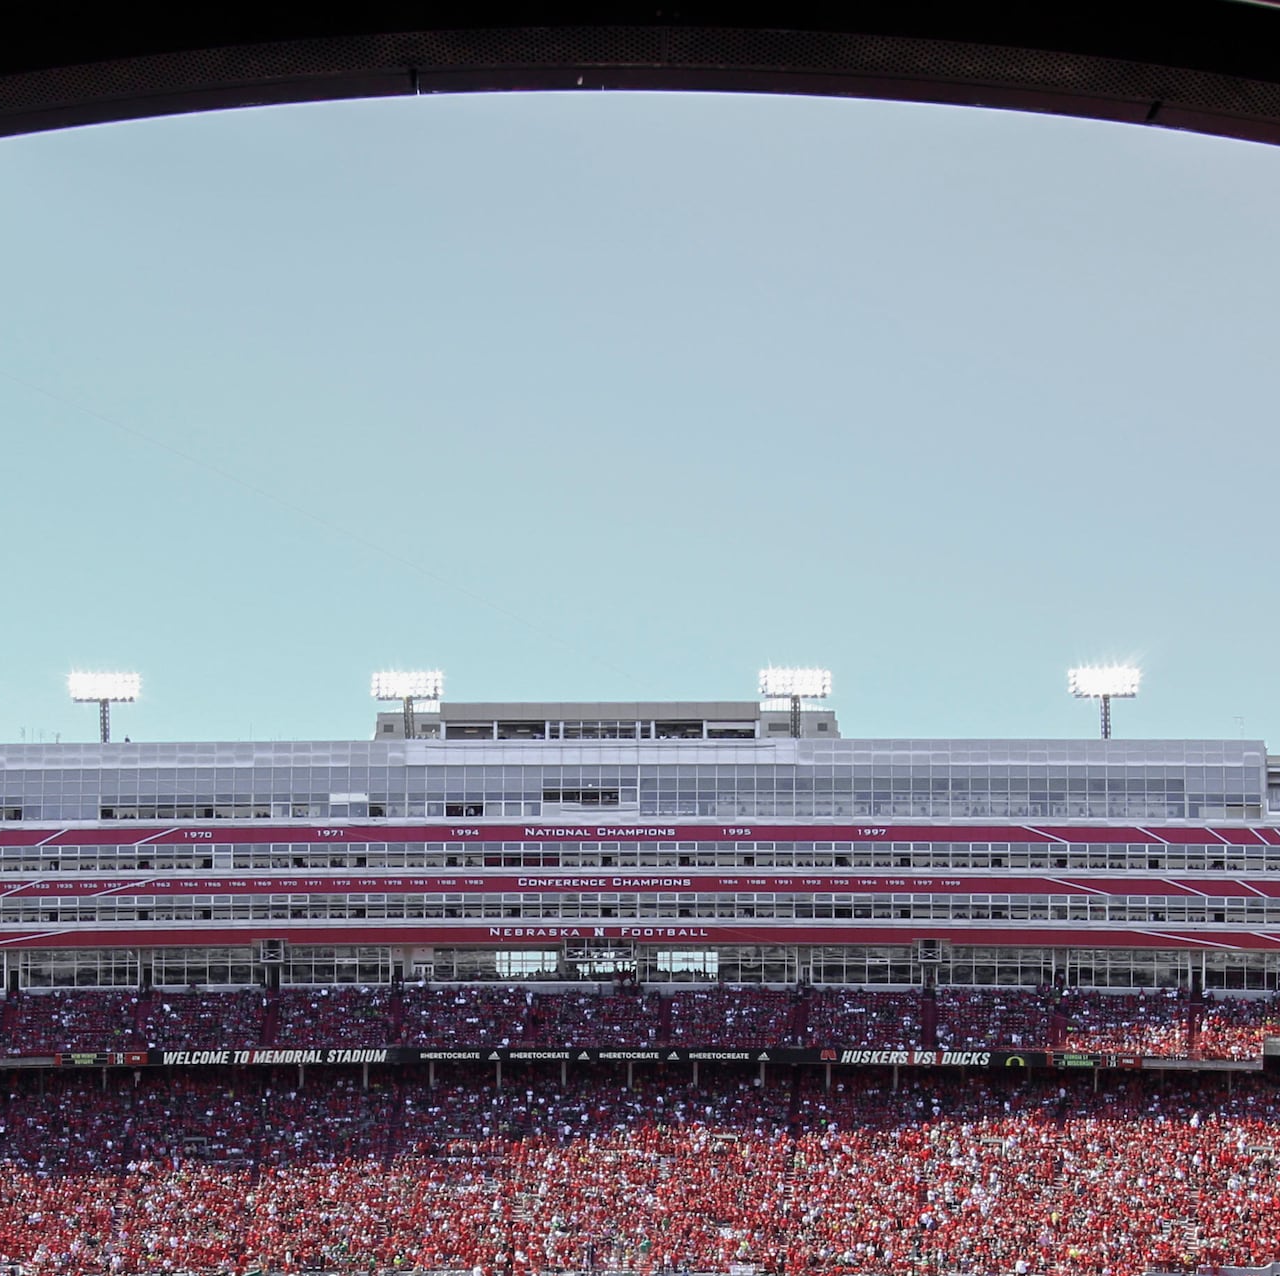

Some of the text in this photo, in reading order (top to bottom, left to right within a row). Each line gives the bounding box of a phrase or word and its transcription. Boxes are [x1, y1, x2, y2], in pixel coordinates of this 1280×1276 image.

[524, 827, 675, 837] NATIONAL CHAMPIONS
[722, 828, 751, 836] 1995
[857, 828, 887, 836] 1997
[517, 877, 691, 887] CONFERENCE CHAMPIONS
[489, 927, 709, 937] NEBRASKA N FOOTBALL
[163, 1048, 387, 1065] WELCOME TO MEMORIAL STADIUM
[840, 1050, 990, 1066] HUSKERS DUCKS
